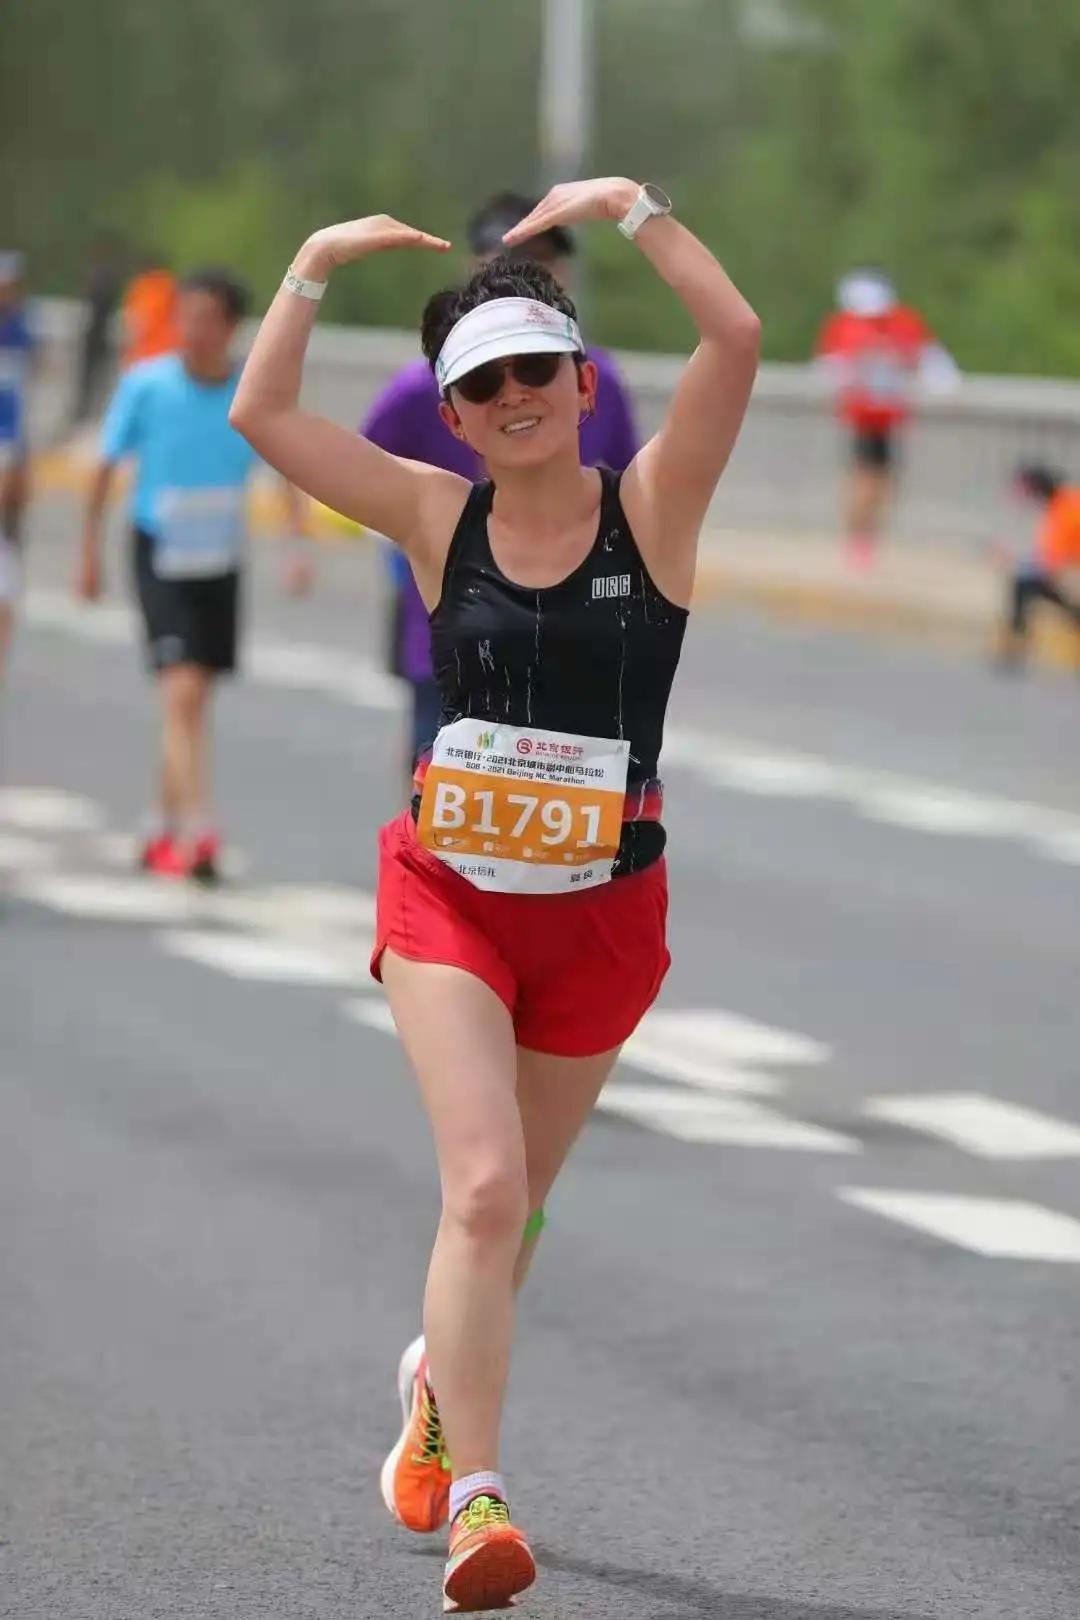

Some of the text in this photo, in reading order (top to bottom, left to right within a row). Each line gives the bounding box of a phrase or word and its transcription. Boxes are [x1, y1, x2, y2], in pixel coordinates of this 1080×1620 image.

[592, 574, 631, 598] URG
[536, 742, 583, 756] 北京银行
[487, 765, 505, 774] 2021
[506, 768, 534, 780] Beijing
[535, 772, 546, 780] MC
[548, 774, 585, 785] Marathon
[432, 782, 604, 848] B1791
